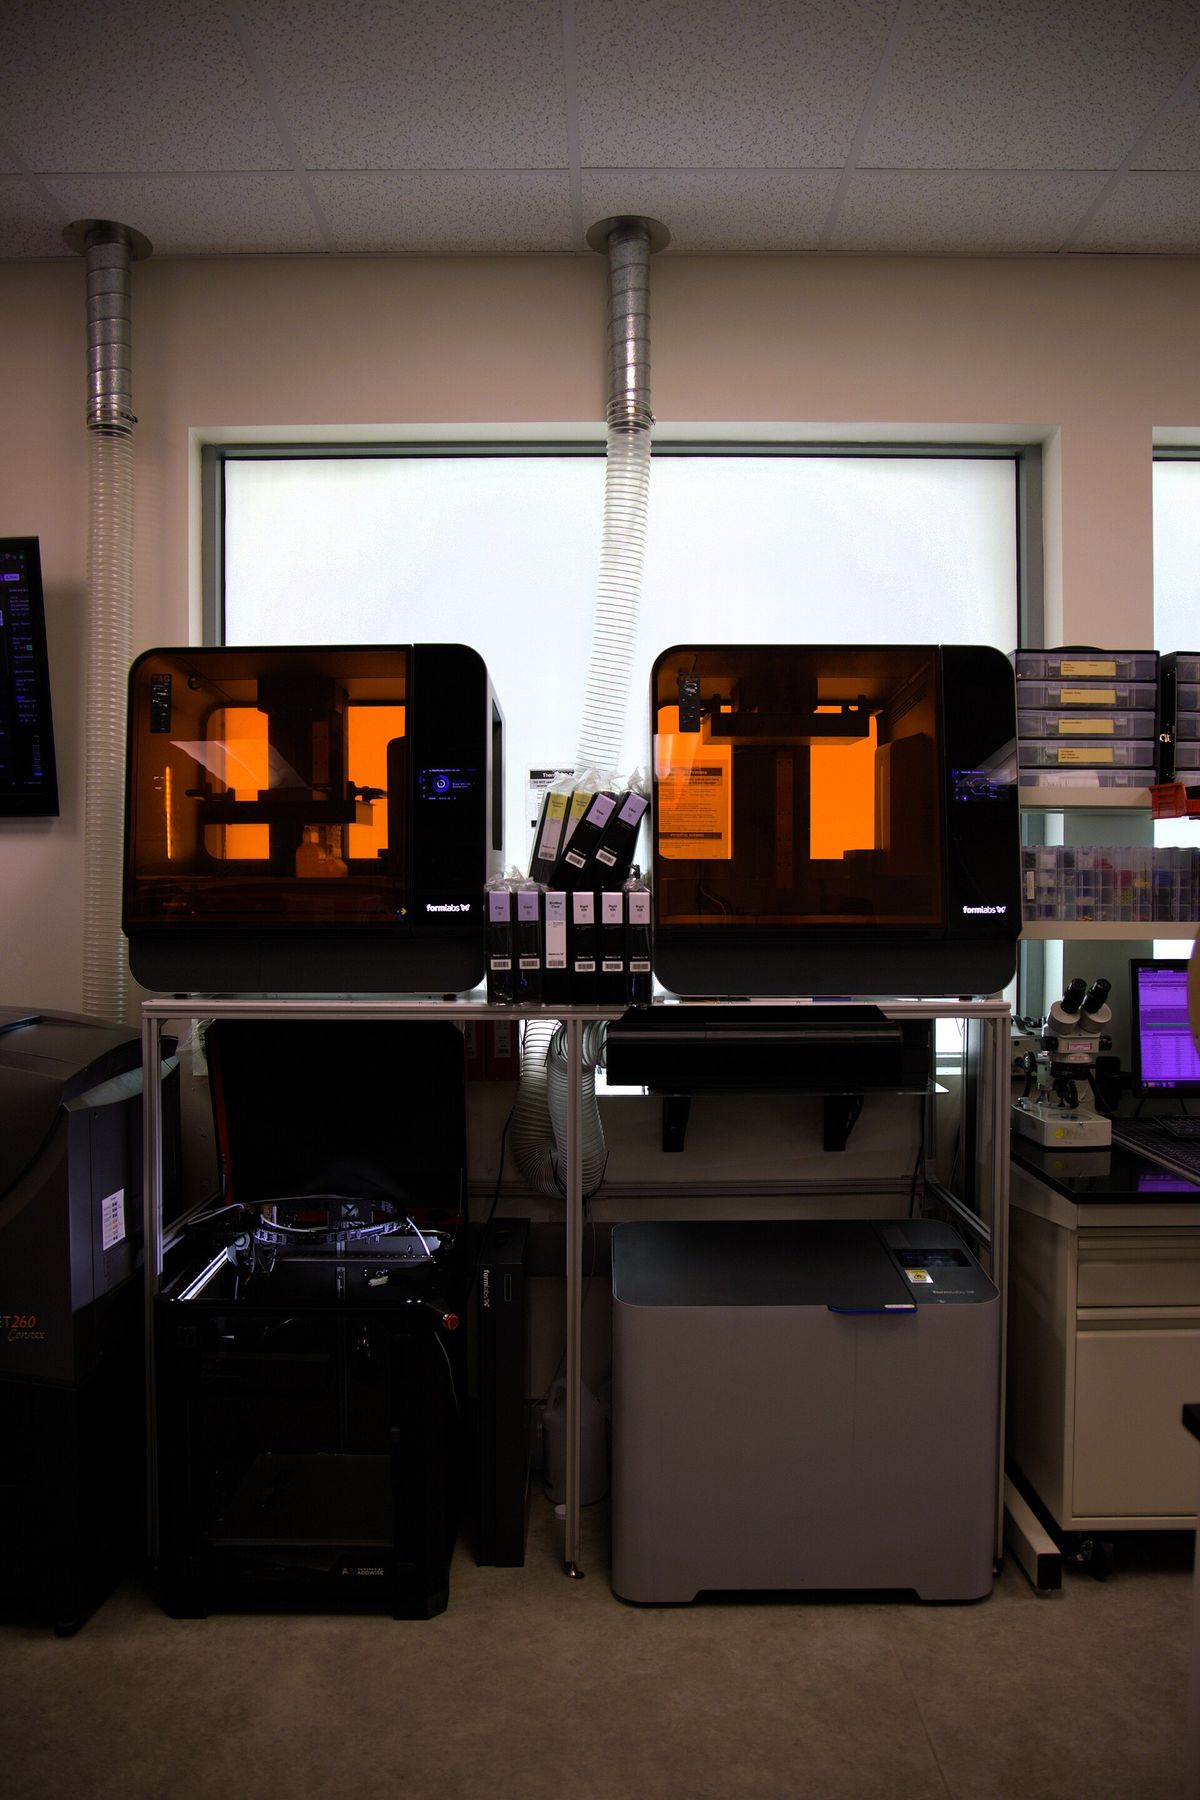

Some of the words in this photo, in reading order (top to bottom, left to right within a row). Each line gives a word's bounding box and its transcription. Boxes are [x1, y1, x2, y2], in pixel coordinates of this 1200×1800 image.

[426, 903, 460, 912] formlabs
[963, 905, 996, 914] formlabs
[482, 1269, 490, 1298] formlabs
